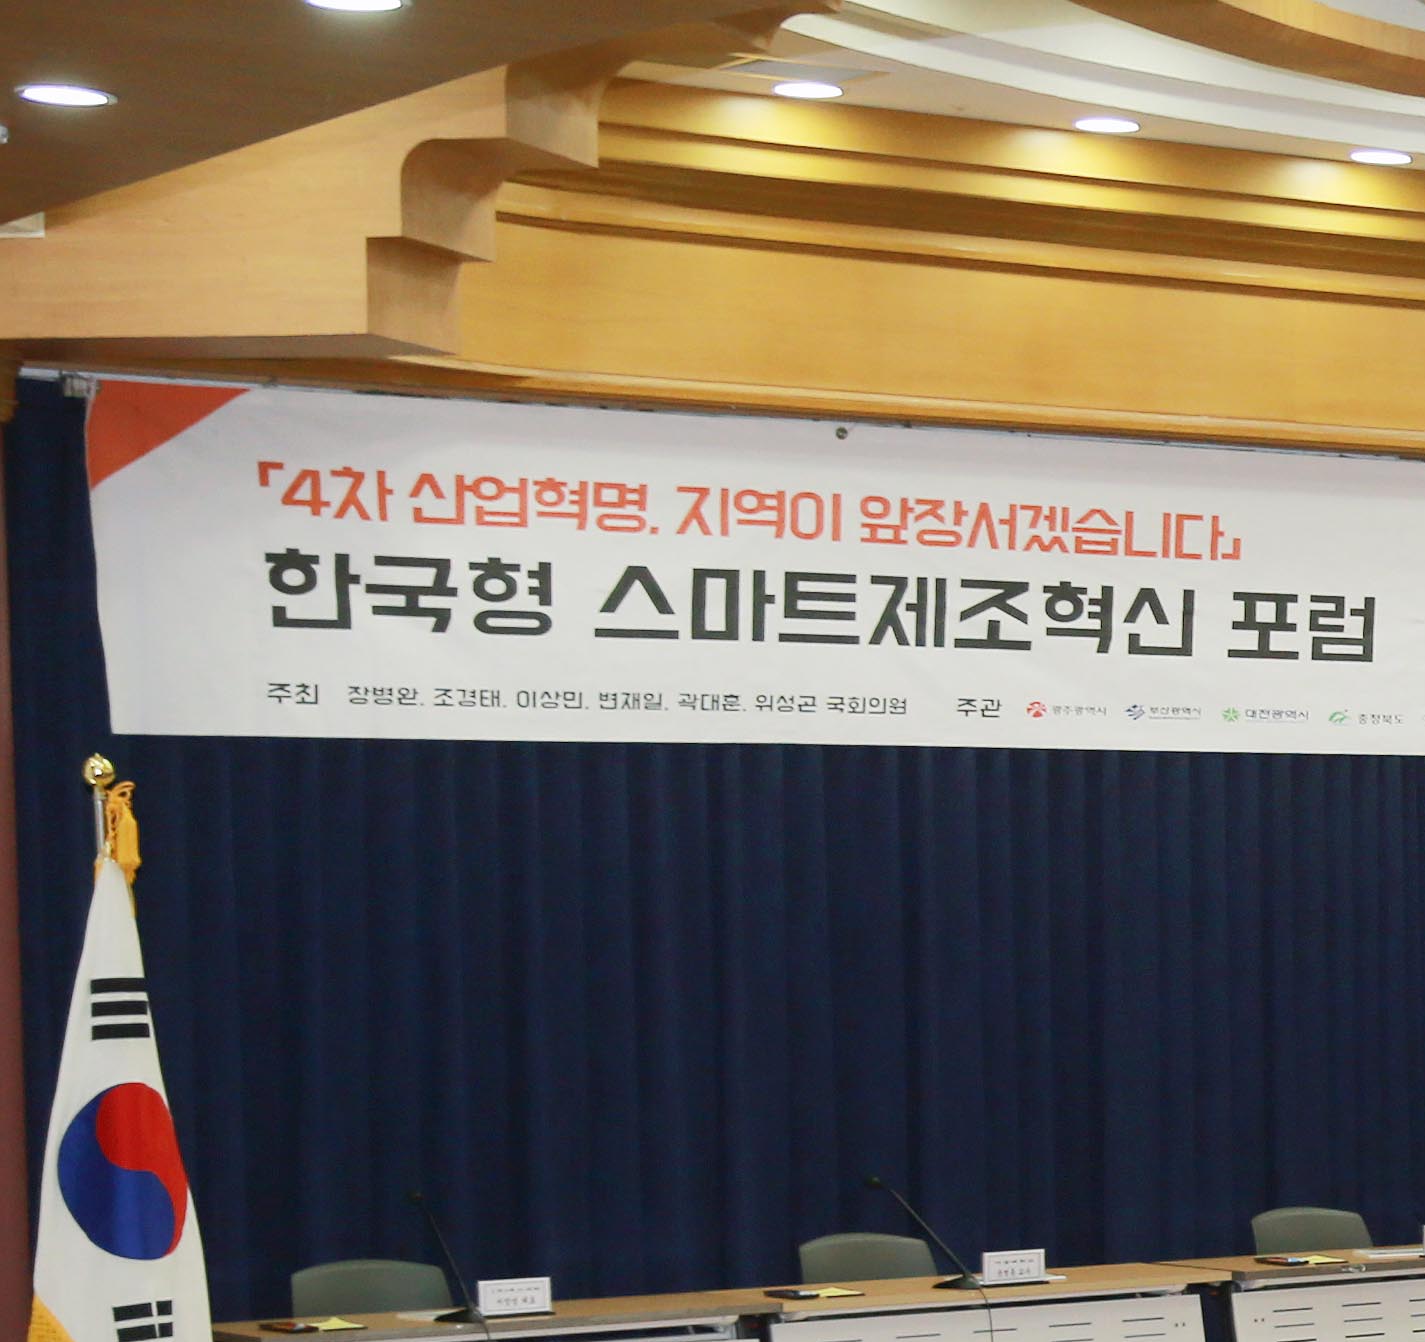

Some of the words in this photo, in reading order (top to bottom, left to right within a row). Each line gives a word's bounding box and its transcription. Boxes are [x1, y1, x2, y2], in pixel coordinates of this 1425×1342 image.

[675, 485, 842, 543] 지역이
[859, 494, 1242, 562] 앞장서겠습니다」
[264, 547, 553, 636] 한국형
[594, 565, 1195, 657] 스마트제조혁신
[1226, 590, 1376, 663] 포럼
[266, 682, 319, 705] 주최
[754, 694, 817, 714] 위성곤
[825, 696, 908, 716] 국회의원
[956, 697, 1001, 718] 주관
[1244, 708, 1310, 722] 대전광역시
